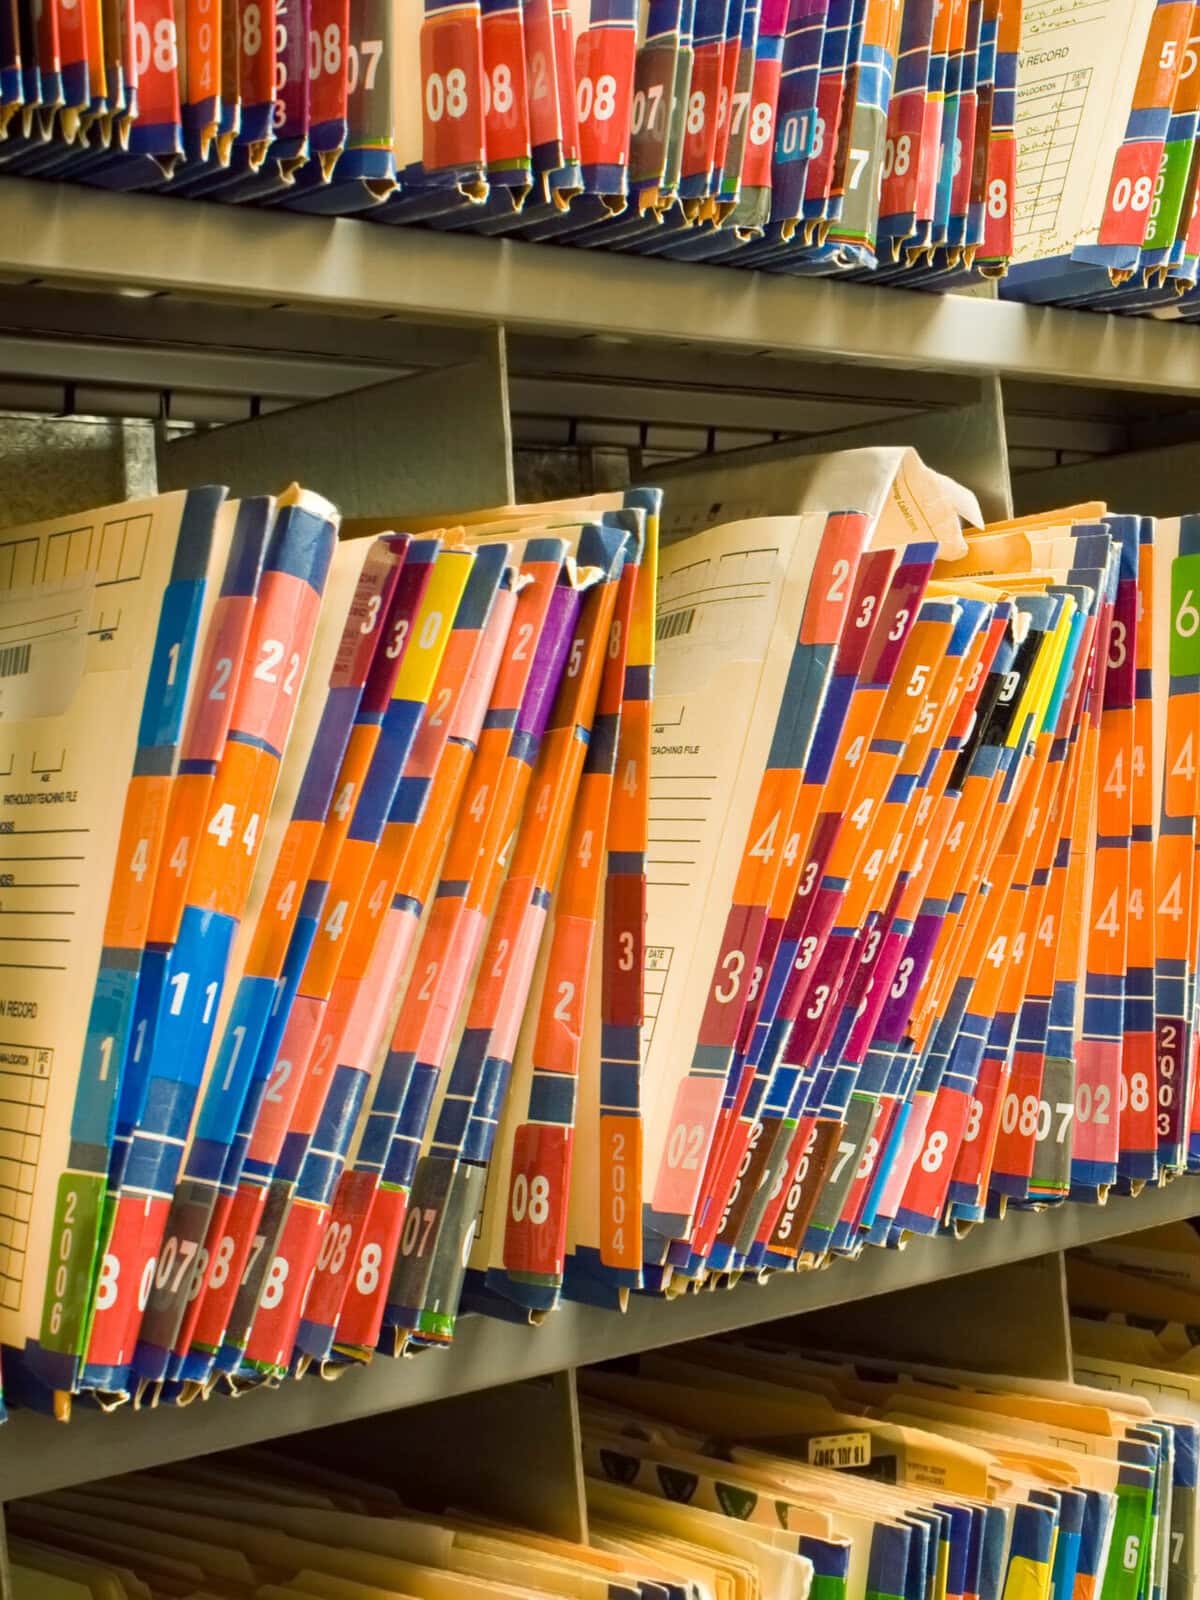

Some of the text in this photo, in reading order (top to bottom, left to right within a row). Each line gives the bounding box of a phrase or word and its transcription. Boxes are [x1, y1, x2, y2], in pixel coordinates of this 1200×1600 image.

[133, 20, 178, 76] 08
[347, 40, 383, 95] 07
[1027, 47, 1069, 66] RECORD
[1159, 41, 1177, 69] 5
[425, 68, 468, 122] 08
[577, 75, 616, 123] 08
[632, 85, 663, 136] 07
[784, 116, 808, 153] 01
[988, 179, 1007, 219] 8
[1112, 177, 1151, 211] 08
[827, 560, 849, 601] 2
[361, 596, 381, 635] 3
[419, 612, 442, 648] 0
[889, 609, 908, 641] 3
[1175, 590, 1199, 637] 6
[254, 639, 284, 682] 2
[512, 624, 534, 660] 2
[1107, 621, 1126, 669] 3
[209, 658, 232, 700] 2
[1000, 671, 1019, 697] 9
[429, 689, 451, 726] 2
[913, 702, 937, 734] 5
[651, 746, 699, 755] EACHING FILE
[845, 736, 865, 767] 4
[1171, 732, 1195, 781] 4
[1103, 753, 1126, 799] 4
[334, 783, 354, 821] 4
[470, 785, 489, 822] 4
[208, 803, 235, 847] 4
[749, 809, 780, 864] 4
[131, 839, 147, 882] 4
[863, 849, 883, 880] 4
[1094, 887, 1120, 937] 4
[1157, 872, 1183, 920] 4
[325, 901, 348, 941] 4
[648, 950, 664, 959] DATE
[170, 972, 190, 1015] 1
[418, 963, 439, 1000] 2
[715, 951, 744, 1003] 3
[891, 957, 914, 998] 3
[7, 1001, 37, 1018] RECORD
[554, 981, 575, 1021] 2
[807, 985, 829, 1019] 3
[100, 1037, 114, 1081] 1
[223, 1026, 246, 1090] 1
[312, 1034, 333, 1075] 2
[1158, 1026, 1177, 1134] 2003
[1001, 1095, 1038, 1136] 08
[1036, 1103, 1074, 1143] 07
[1074, 1084, 1110, 1124] 02
[668, 1125, 704, 1170] 02
[512, 1174, 549, 1224] 08
[612, 1134, 625, 1255] 2004
[777, 1128, 817, 1240] 2005
[318, 1222, 351, 1274] 08
[402, 1207, 436, 1257] 07
[49, 1192, 77, 1334] 2006
[156, 1236, 198, 1292] 07
[1123, 1535, 1139, 1566] 6
